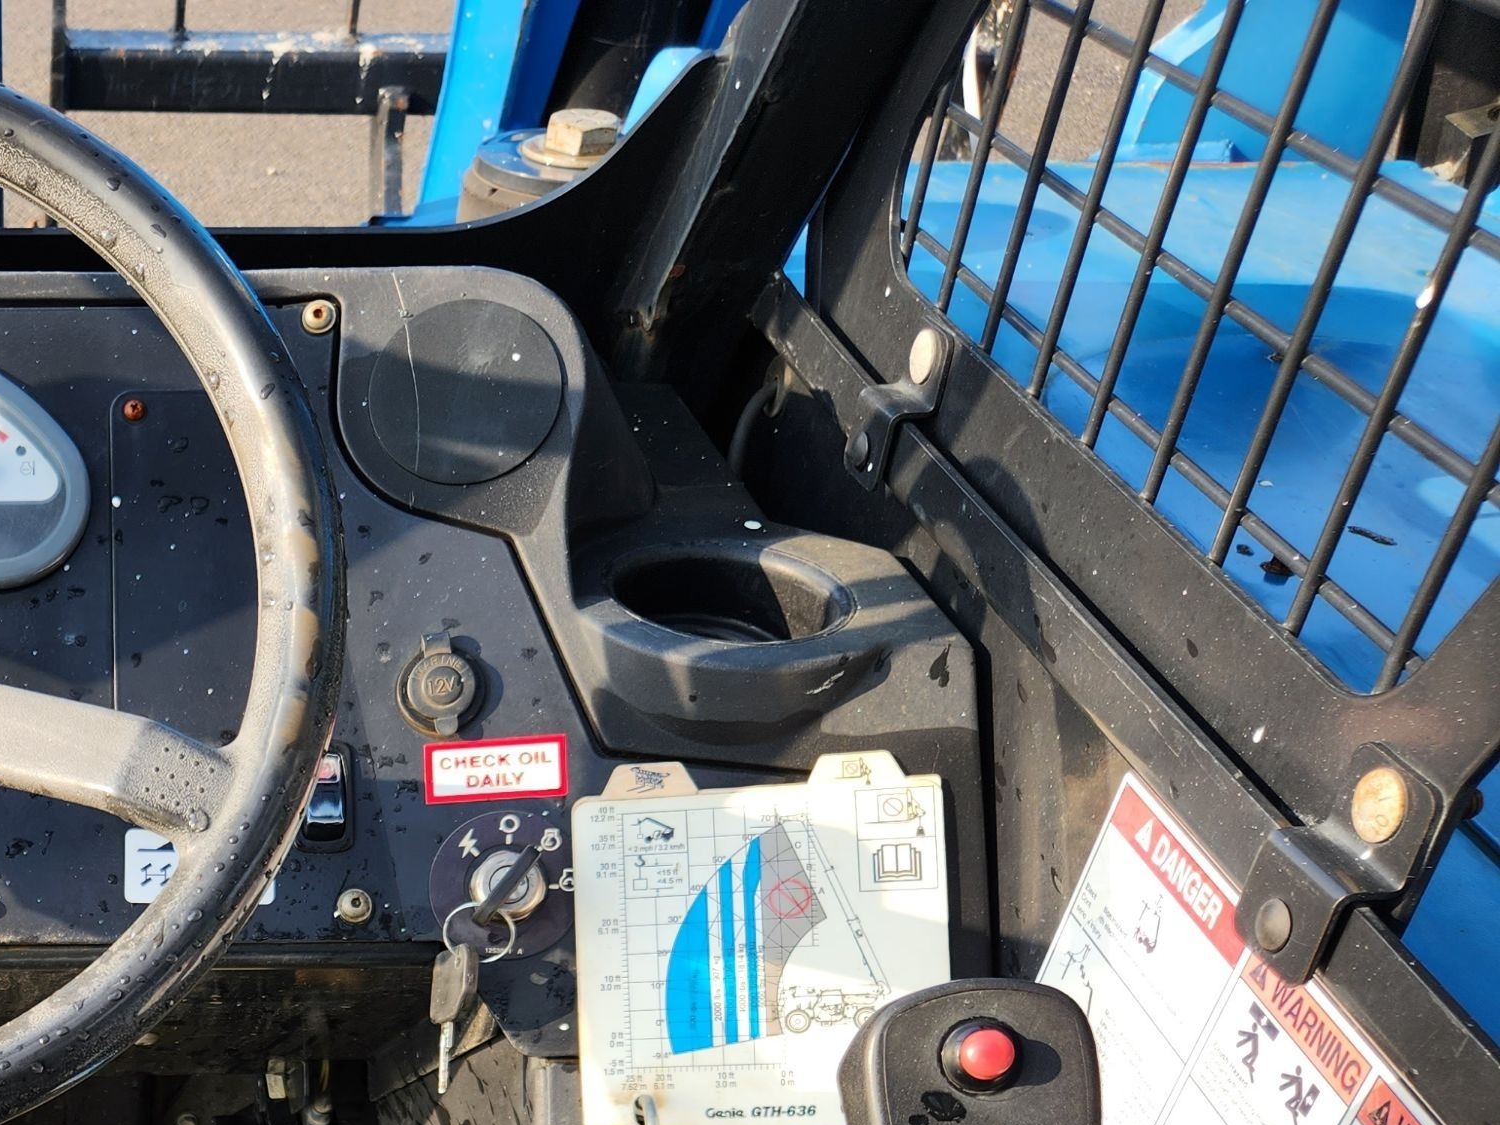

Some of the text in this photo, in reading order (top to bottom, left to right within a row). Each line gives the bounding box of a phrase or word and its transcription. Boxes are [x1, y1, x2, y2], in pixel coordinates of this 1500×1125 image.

[428, 676, 455, 696] 12V
[440, 751, 552, 770] CHECK OIL
[466, 771, 524, 788] DAILY
[592, 843, 606, 851] 10.7
[795, 841, 801, 849] C
[600, 863, 609, 871] 30
[1152, 835, 1223, 929] DANGER
[818, 887, 825, 895] A
[602, 919, 611, 927] 20
[605, 975, 613, 983] 10
[1271, 980, 1361, 1094] WARNING
[706, 1105, 817, 1118] Genie GTH-636
